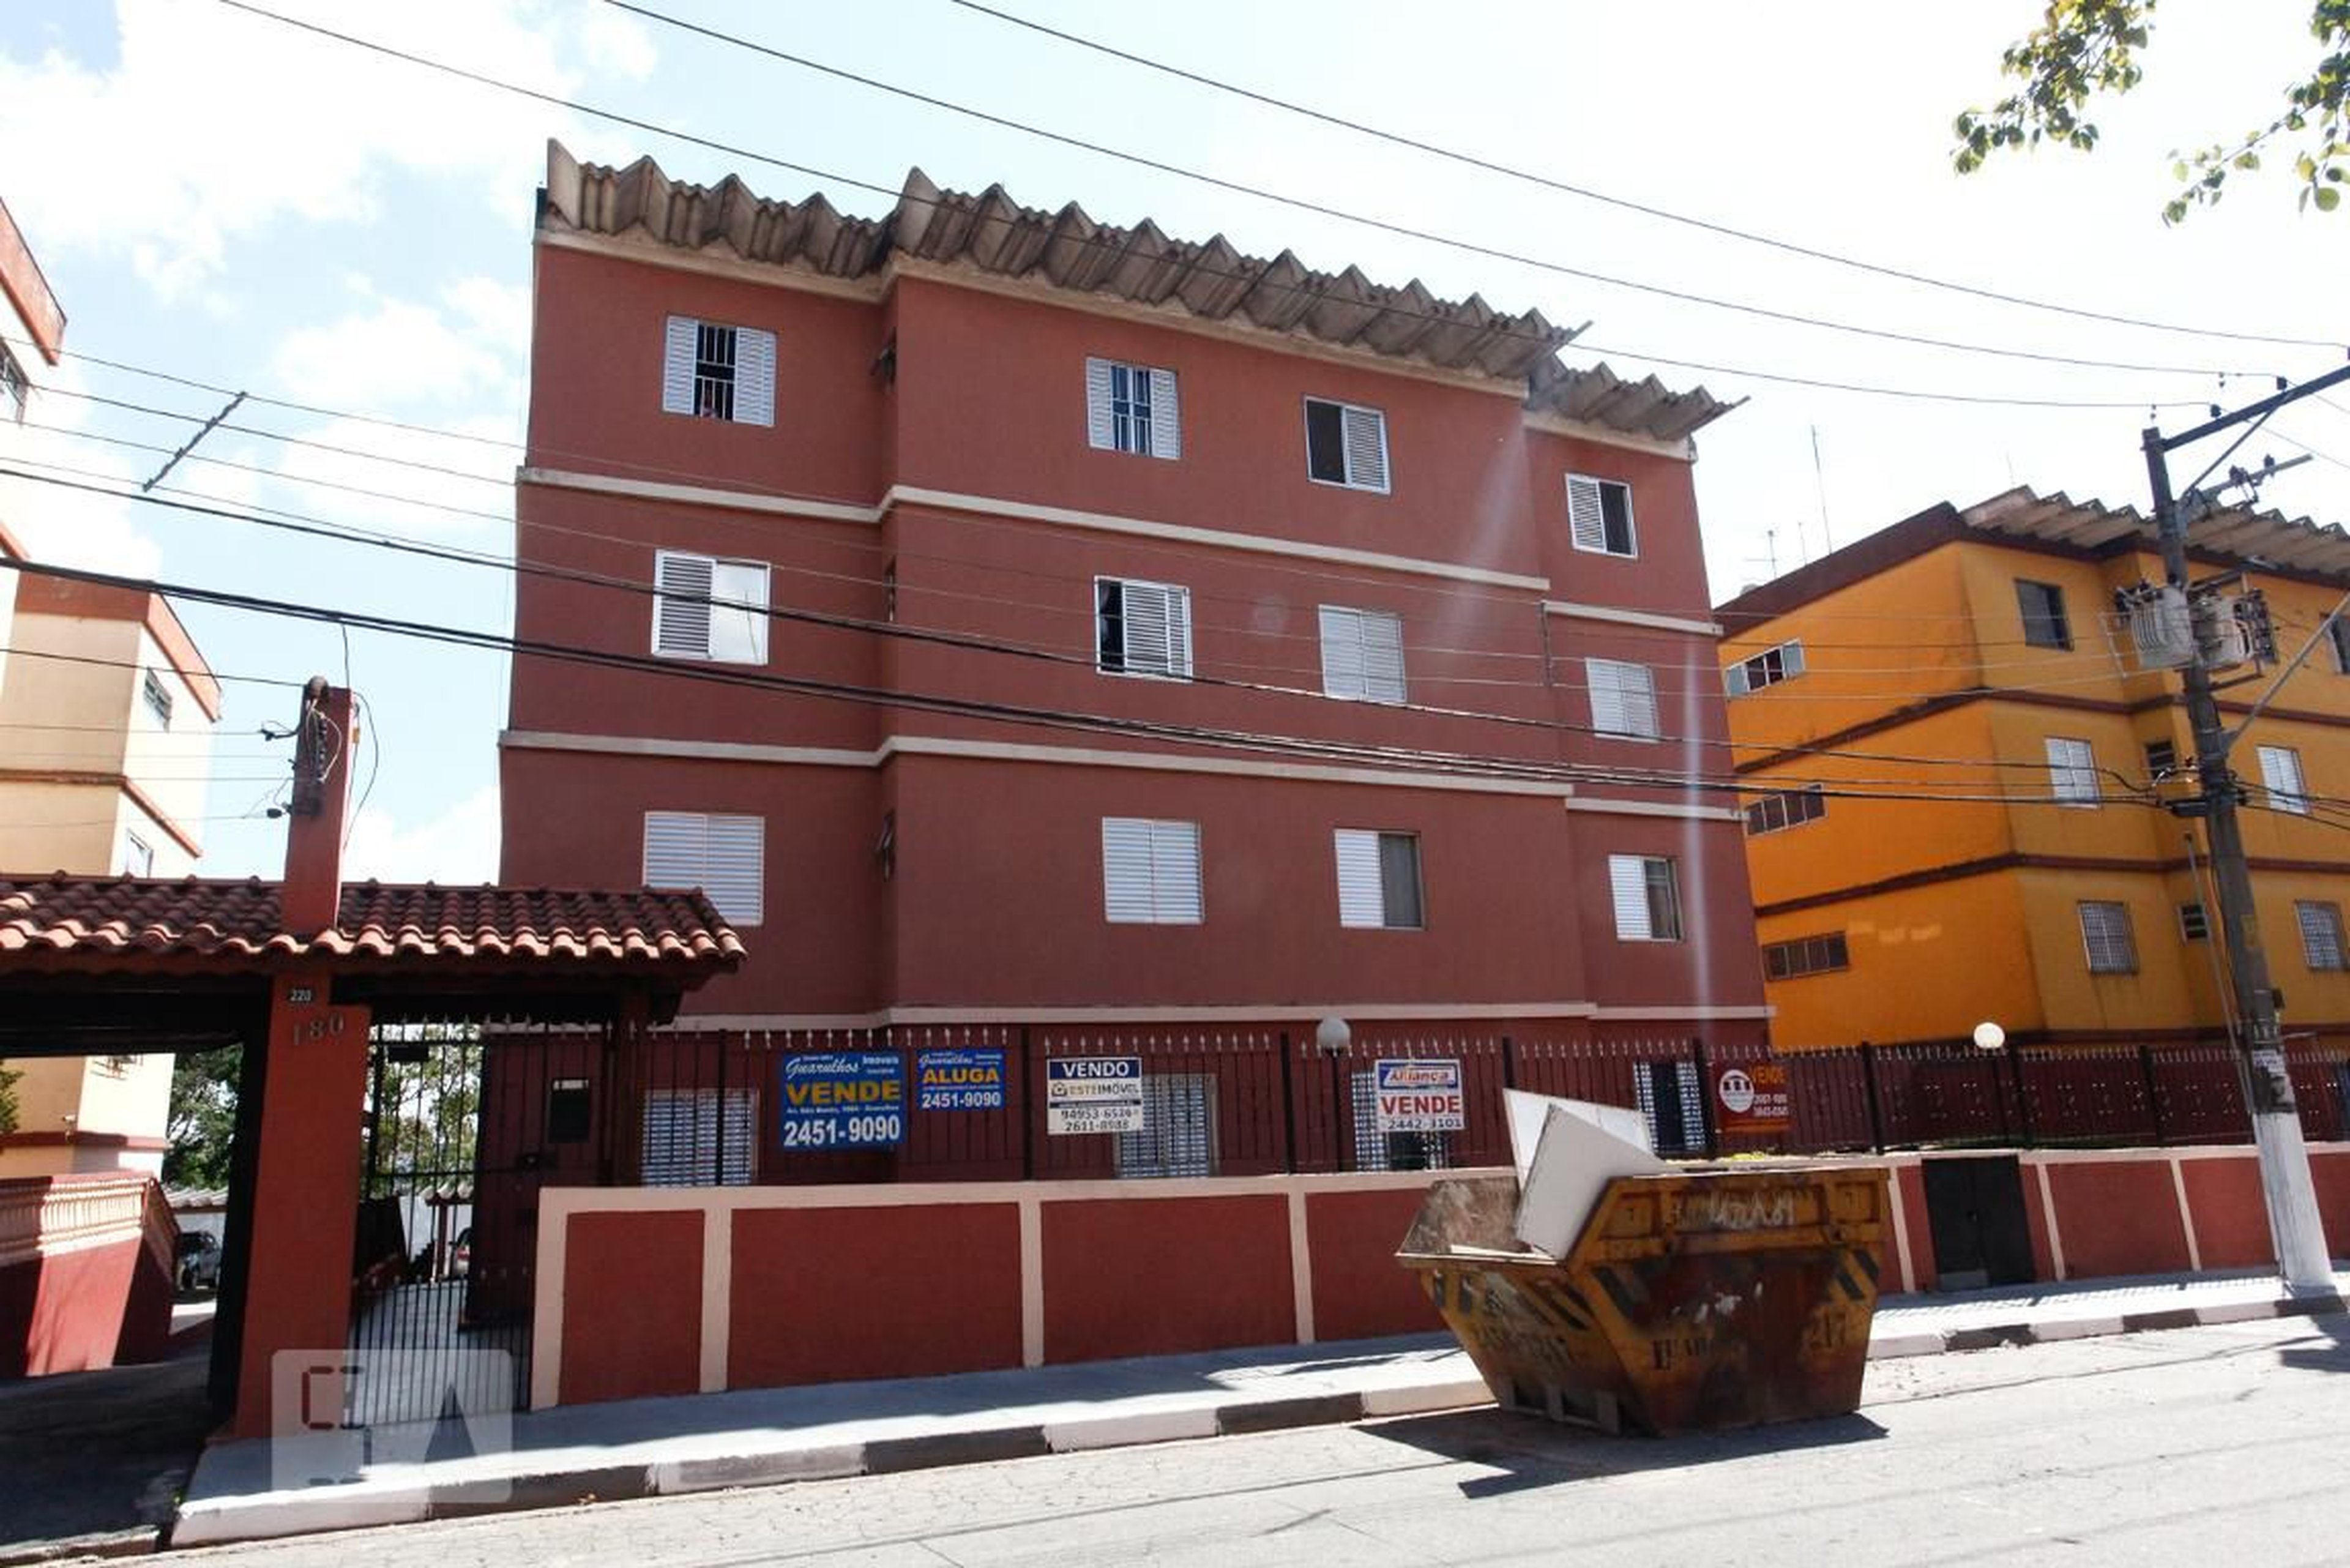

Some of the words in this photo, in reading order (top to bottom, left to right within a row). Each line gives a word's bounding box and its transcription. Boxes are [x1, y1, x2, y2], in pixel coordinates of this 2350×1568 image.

[290, 989, 311, 1001] 220
[294, 1013, 344, 1046] 180
[786, 1055, 859, 1079] Guarulhos
[922, 1067, 1000, 1084] ALUGA
[1062, 1061, 1130, 1077] VENDO
[786, 1080, 901, 1105] VENDE
[922, 1091, 1002, 1108] 2451-9090
[1381, 1096, 1461, 1114] VENDE
[784, 1115, 900, 1147] 2451-9090
